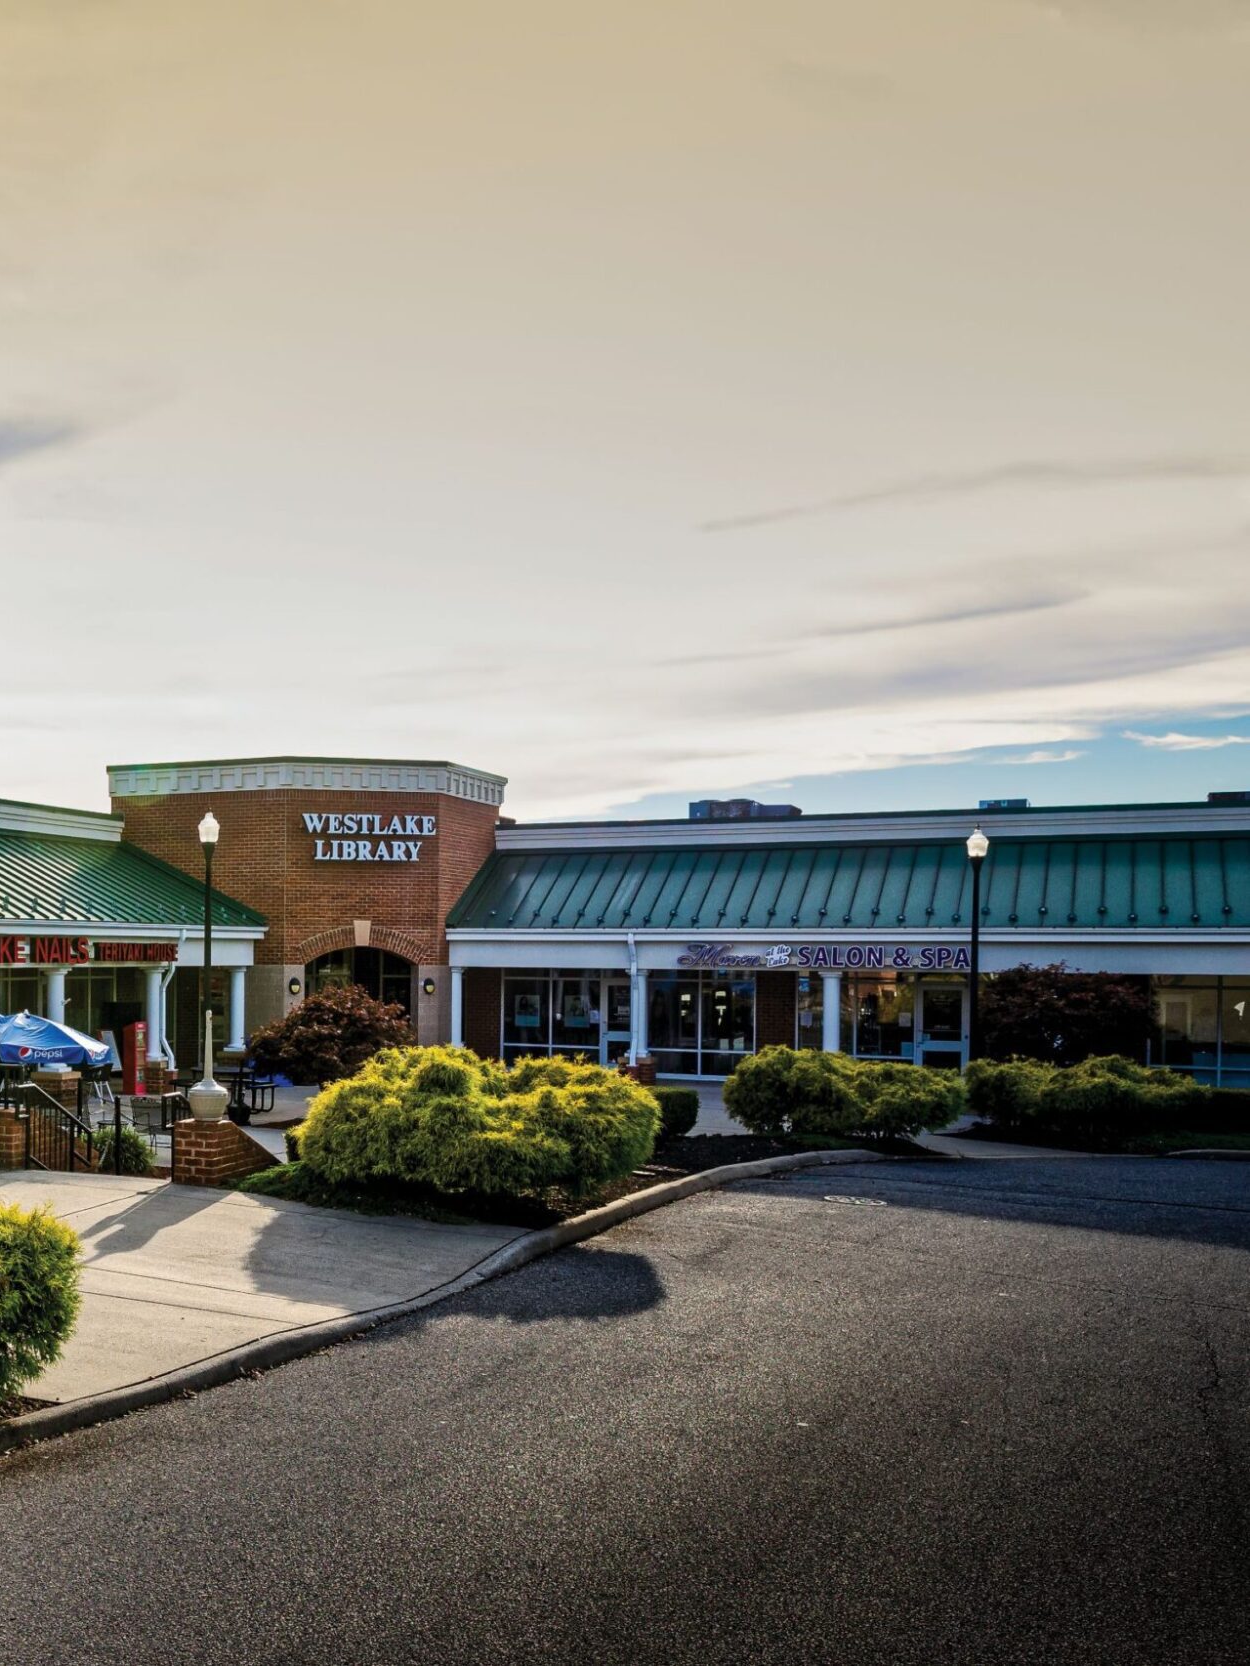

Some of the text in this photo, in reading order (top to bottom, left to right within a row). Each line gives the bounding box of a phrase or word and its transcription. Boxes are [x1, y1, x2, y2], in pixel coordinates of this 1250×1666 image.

[302, 813, 437, 836] WESTLAKE
[314, 840, 422, 862] LIBRARY
[36, 935, 90, 964] NAILS
[99, 942, 178, 961] TERIYAKI HOUSE
[776, 944, 790, 955] the
[797, 945, 972, 969] SALON & SPA
[767, 956, 788, 966] Lake
[34, 1049, 63, 1059] pepsi
